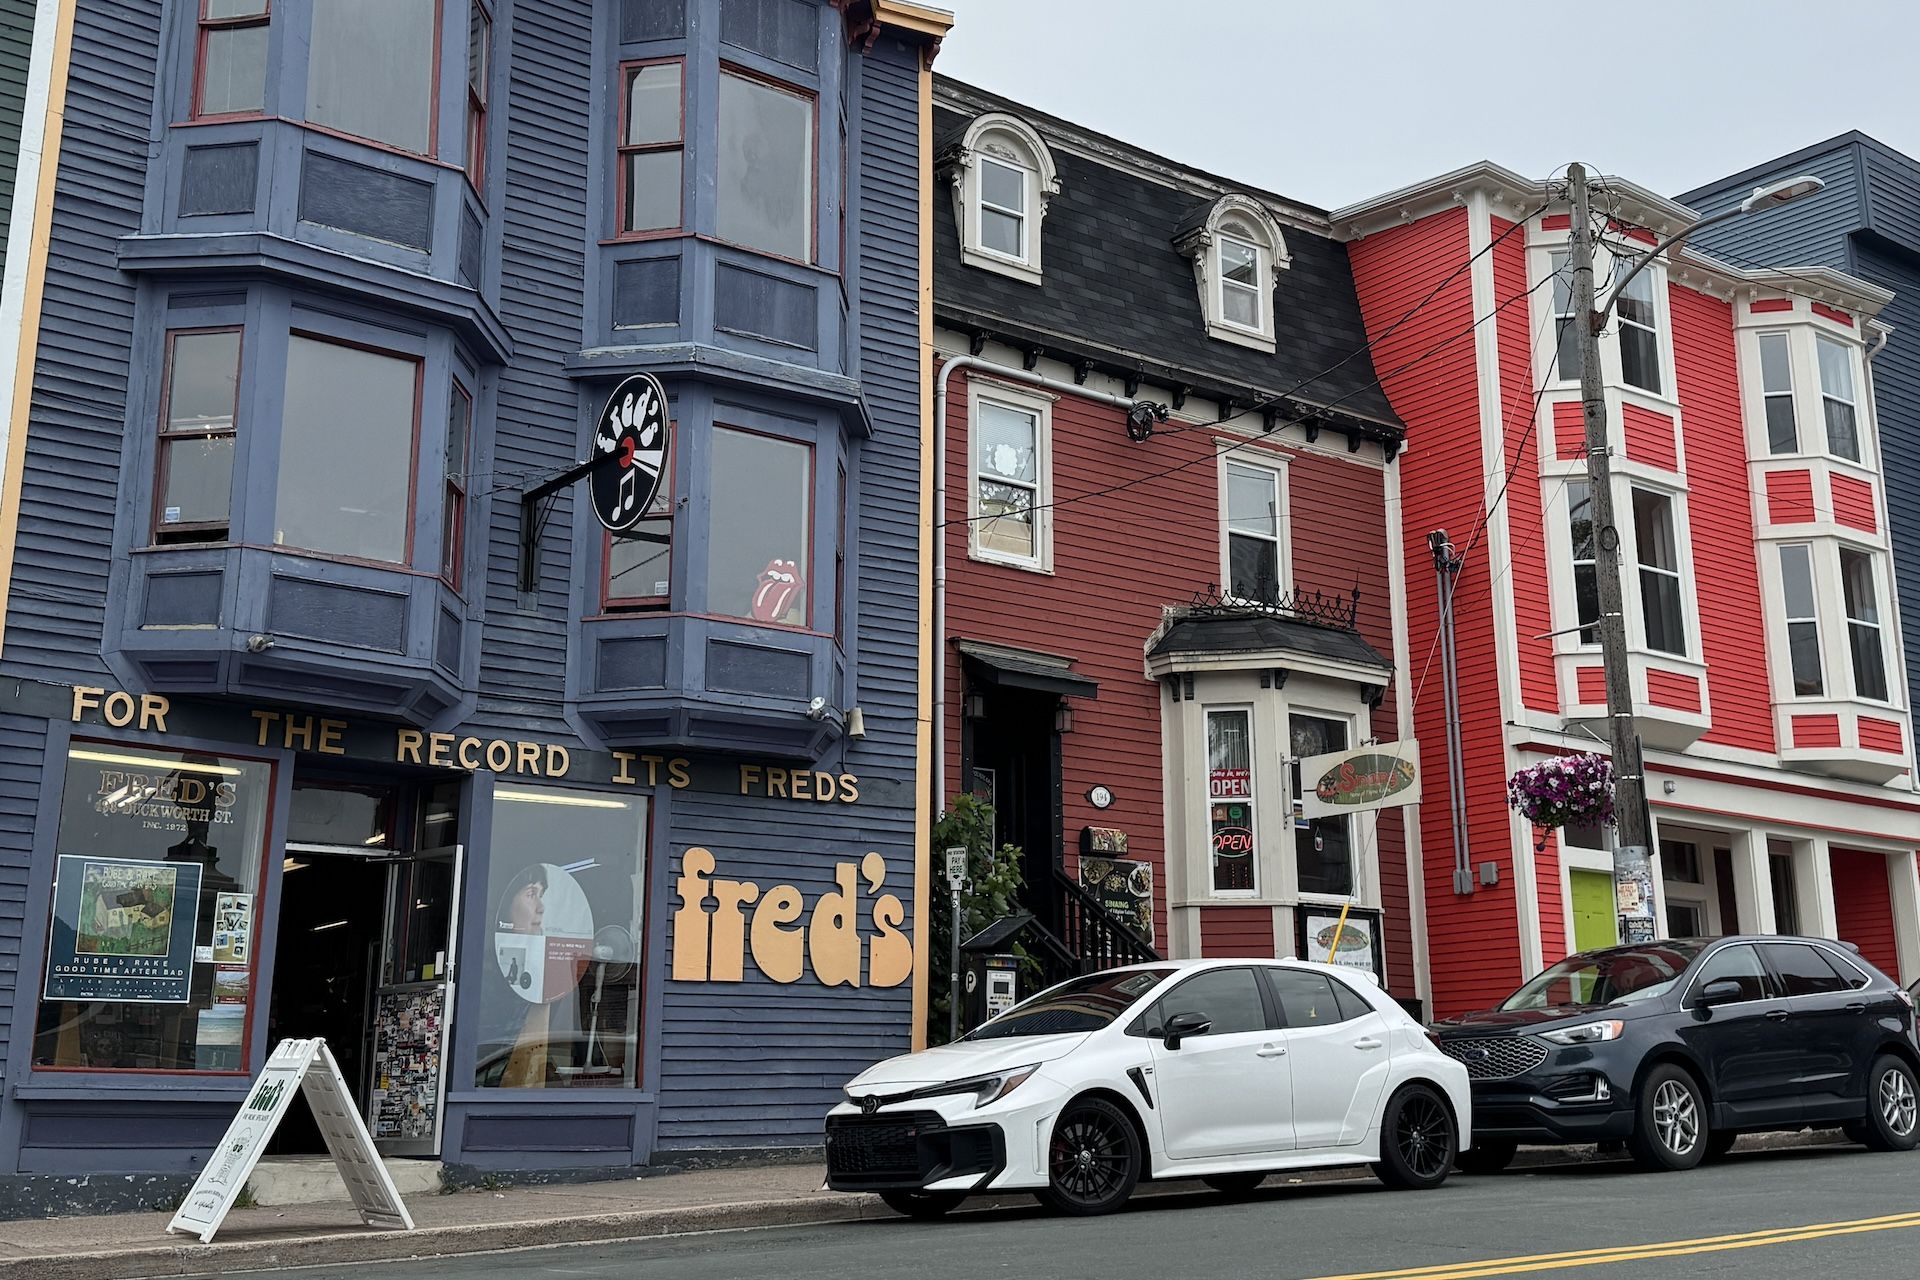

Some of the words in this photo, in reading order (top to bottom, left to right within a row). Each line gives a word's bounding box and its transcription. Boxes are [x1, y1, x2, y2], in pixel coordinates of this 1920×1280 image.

[71, 686, 170, 732] FOR
[251, 710, 348, 755] THE
[397, 729, 570, 777] RECORD
[612, 752, 691, 788] ITS
[740, 764, 860, 802] FREDS
[97, 770, 237, 807] FRED'S
[1211, 780, 1250, 796] OPEN
[122, 802, 210, 822] DUCKWORTH
[214, 810, 234, 824] ST.
[1213, 835, 1251, 850] OPEN
[950, 865, 963, 873] HERE
[673, 847, 913, 988] fred's
[55, 964, 86, 972] GOOD
[93, 966, 118, 974] TIME
[124, 967, 158, 975] AFTER
[73, 957, 108, 965] RUBE
[134, 959, 168, 967] RAKE
[967, 974, 973, 989] P
